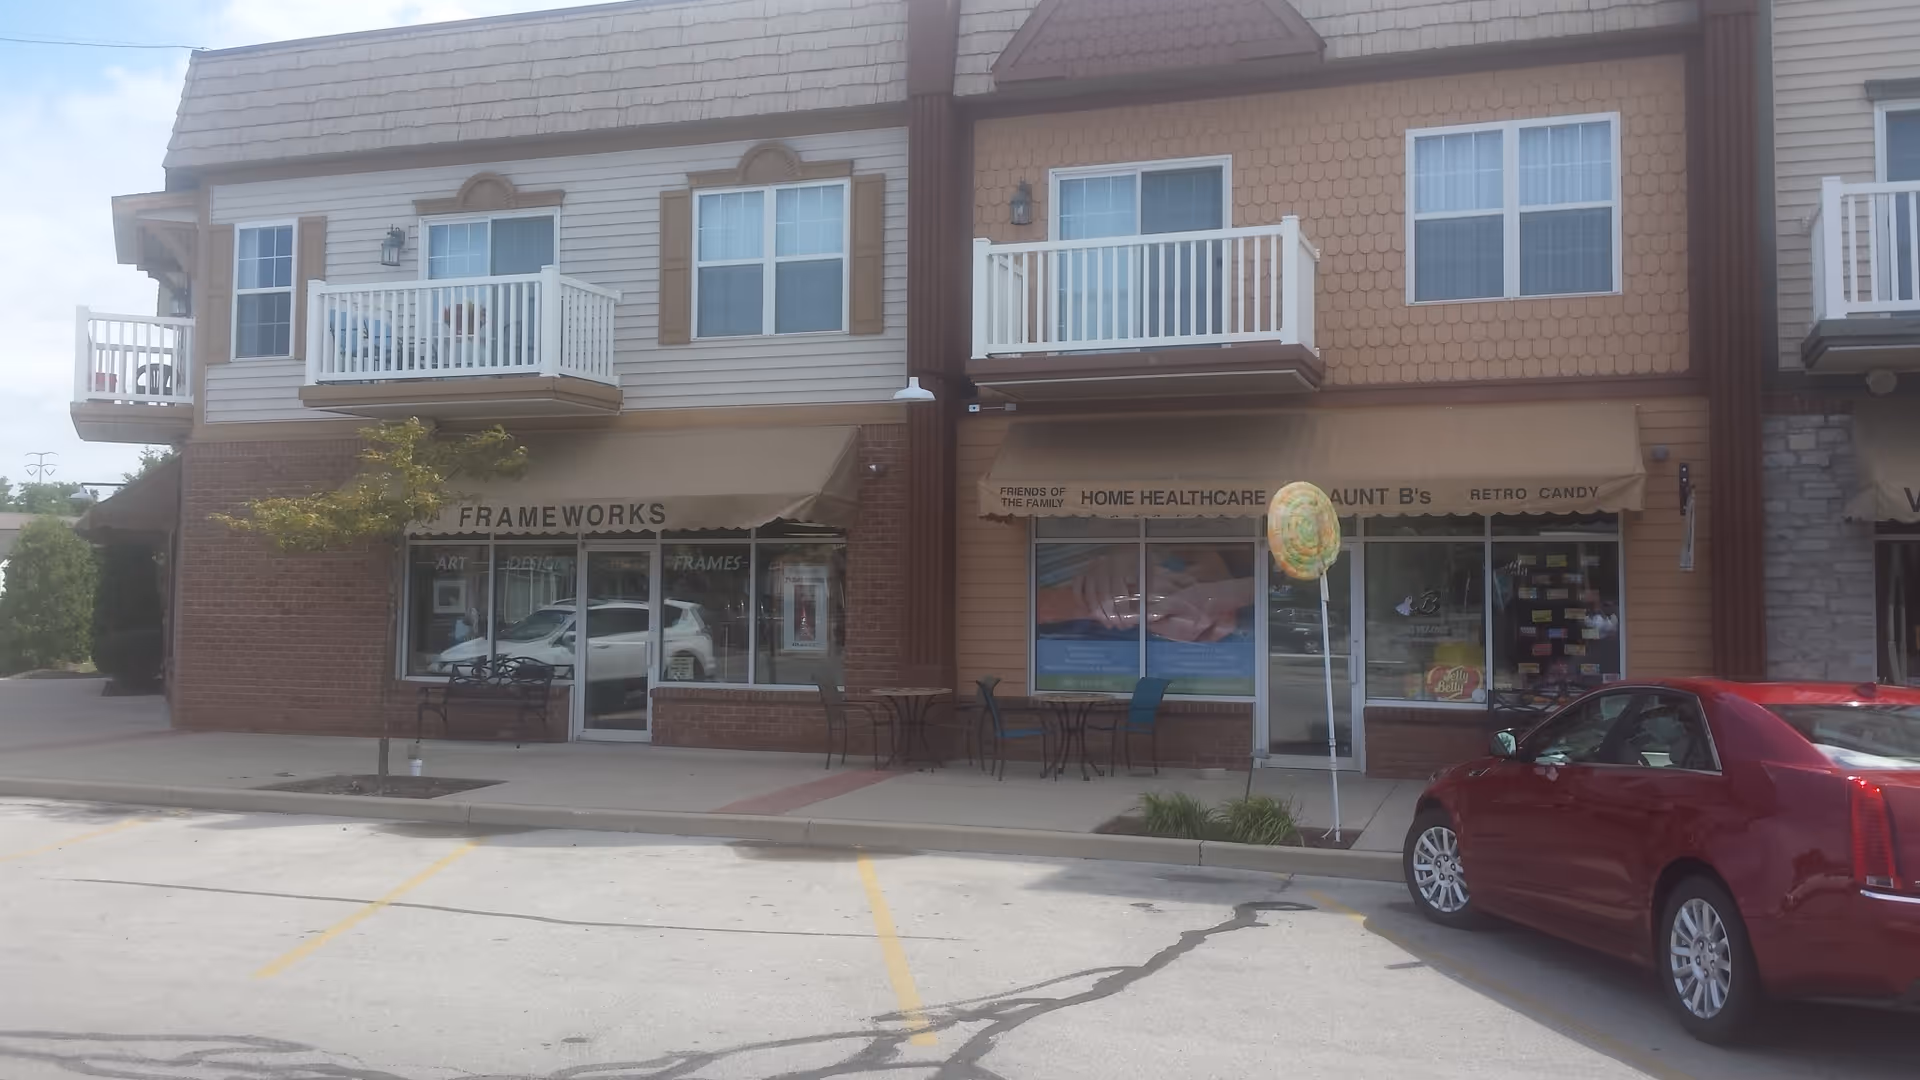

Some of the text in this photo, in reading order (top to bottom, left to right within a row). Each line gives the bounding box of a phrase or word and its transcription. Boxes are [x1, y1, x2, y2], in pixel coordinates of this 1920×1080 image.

[999, 487, 1067, 497] FRIENDS OF
[1080, 490, 1266, 506] HOME HEALTHCARE
[1329, 487, 1432, 506] AUNT B's
[1470, 486, 1600, 501] RETRO CANDY
[1001, 498, 1065, 508] THE FAMILY
[458, 503, 667, 528] FRAMEWORKS
[435, 556, 468, 571] ART
[673, 555, 742, 571] FRAMES
[1443, 665, 1469, 684] Jelly
[1435, 680, 1464, 698] Belly
